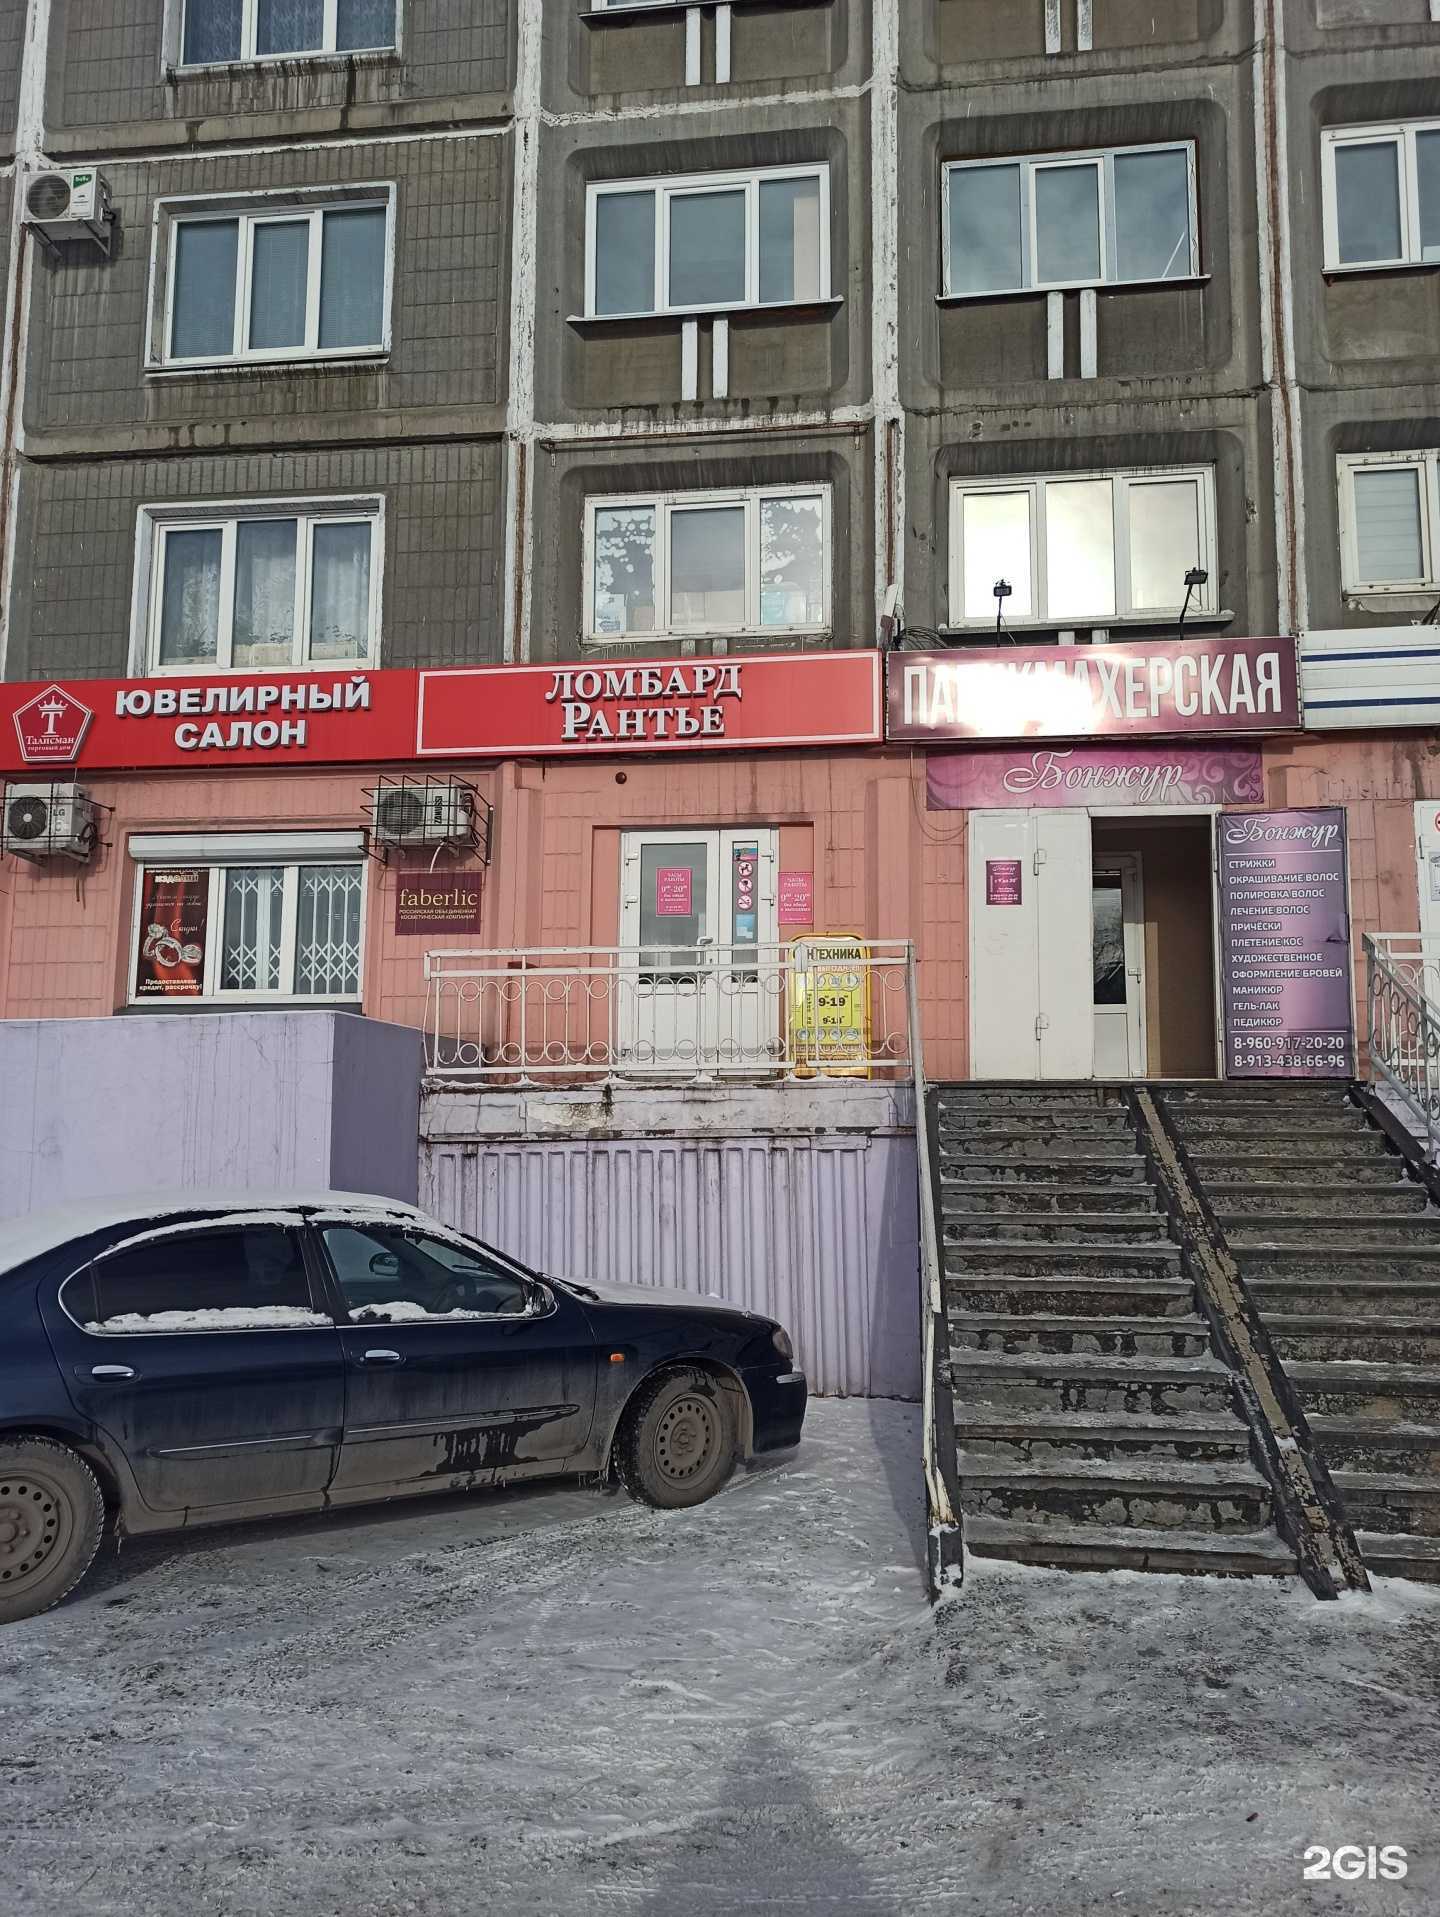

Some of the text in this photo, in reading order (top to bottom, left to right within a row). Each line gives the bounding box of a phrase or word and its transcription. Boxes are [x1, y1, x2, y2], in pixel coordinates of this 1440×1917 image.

[545, 664, 742, 701] ЛОМБАРД
[115, 675, 370, 716] ЮВЕЛИРНЫЙ
[174, 719, 307, 749] САЛОН
[1003, 748, 1183, 802] Бонжур
[53, 808, 65, 817] LG
[1226, 817, 1339, 848] Бонжур
[1229, 860, 1275, 869] СТРИЖКИ
[1229, 872, 1339, 884] ОКРАШИВАНИЕ ВОЛОС
[399, 888, 478, 906] faberlic
[1230, 888, 1325, 900] ПОЛИРОВКА ВОЛОС
[1230, 905, 1309, 916] ЛЕЧЕНИЕ ВОЛОС
[1231, 937, 1303, 947] ПЛЕТЕНИЕ КОС
[1231, 953, 1323, 963] ХУДОЖЕСТВЕННОЕ
[1232, 967, 1343, 979] ОФОРМЛЕНИЕ БРОВЕЙ
[1232, 986, 1283, 995] МАНИКЮР
[1233, 1002, 1280, 1011] ГЕЛЬ-ЛАК
[1233, 1018, 1282, 1027] ПЕДИКЮР
[1234, 1036, 1345, 1050] 8-960-917-20-20
[1234, 1054, 1345, 1067] 8-913-438-66-96
